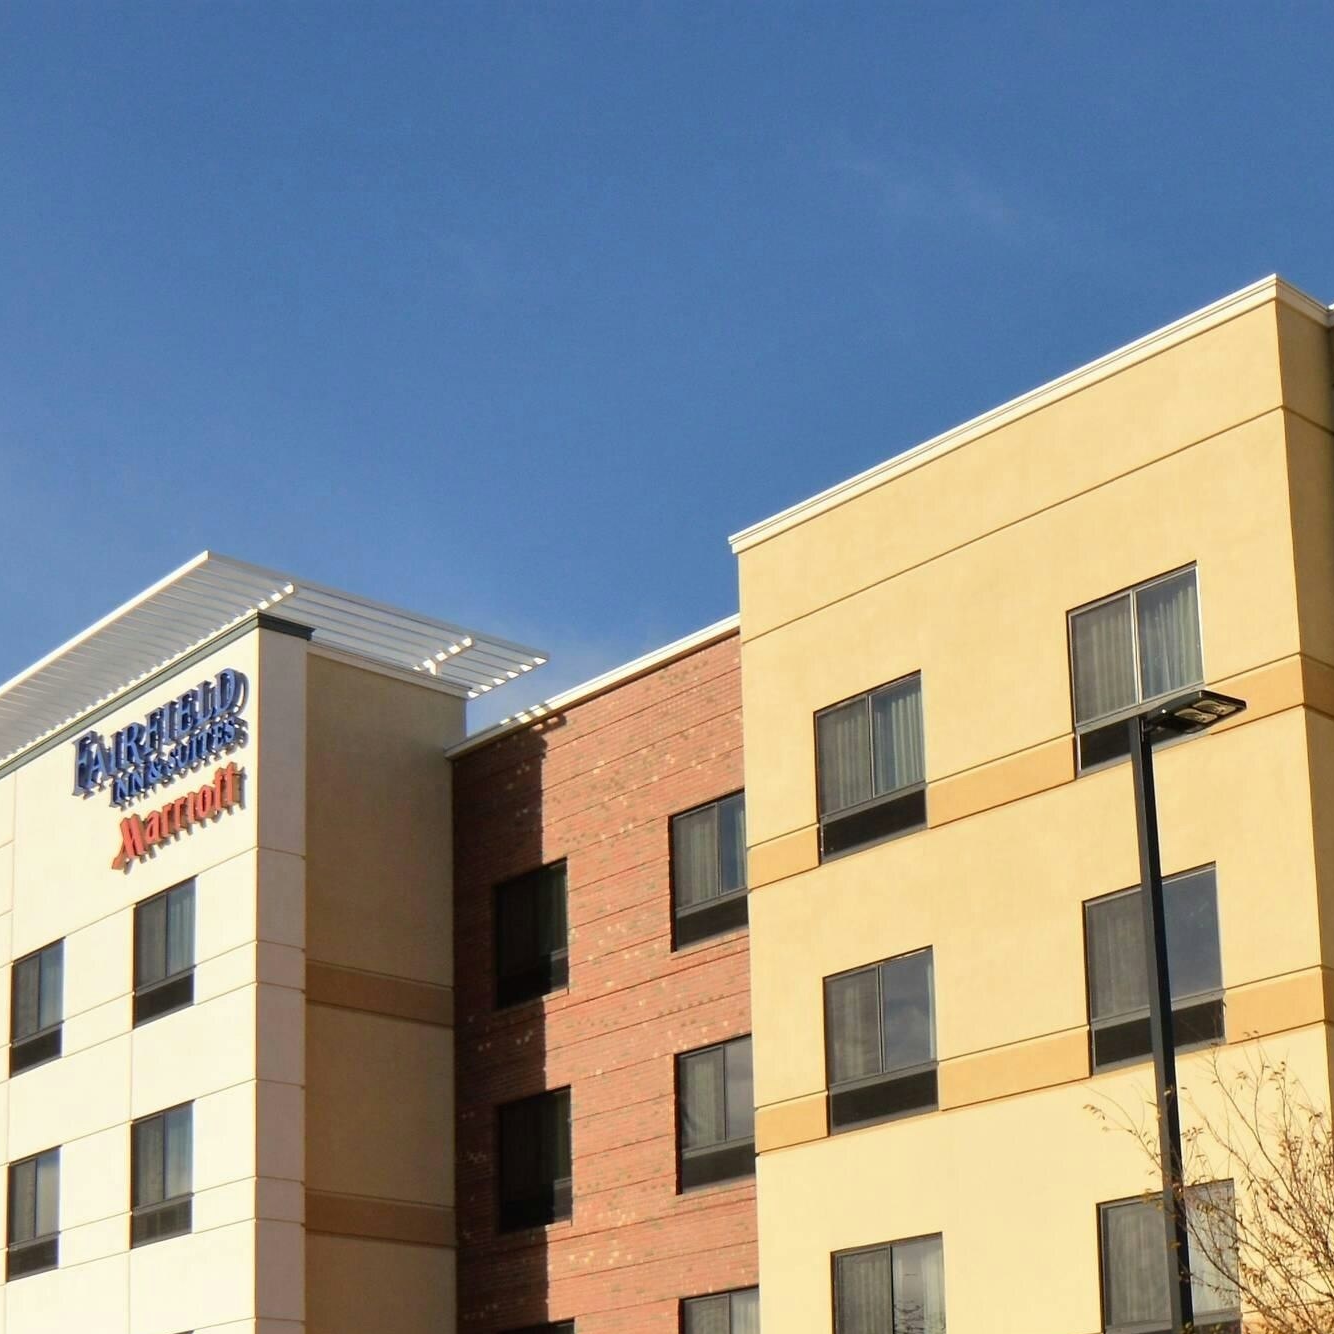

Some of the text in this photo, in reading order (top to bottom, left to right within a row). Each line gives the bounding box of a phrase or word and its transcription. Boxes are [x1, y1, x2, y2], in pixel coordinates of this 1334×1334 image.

[72, 668, 243, 797] FAIRFIELD
[109, 767, 147, 809] INN
[165, 716, 240, 776] SUITES
[111, 761, 239, 870] Marriott
